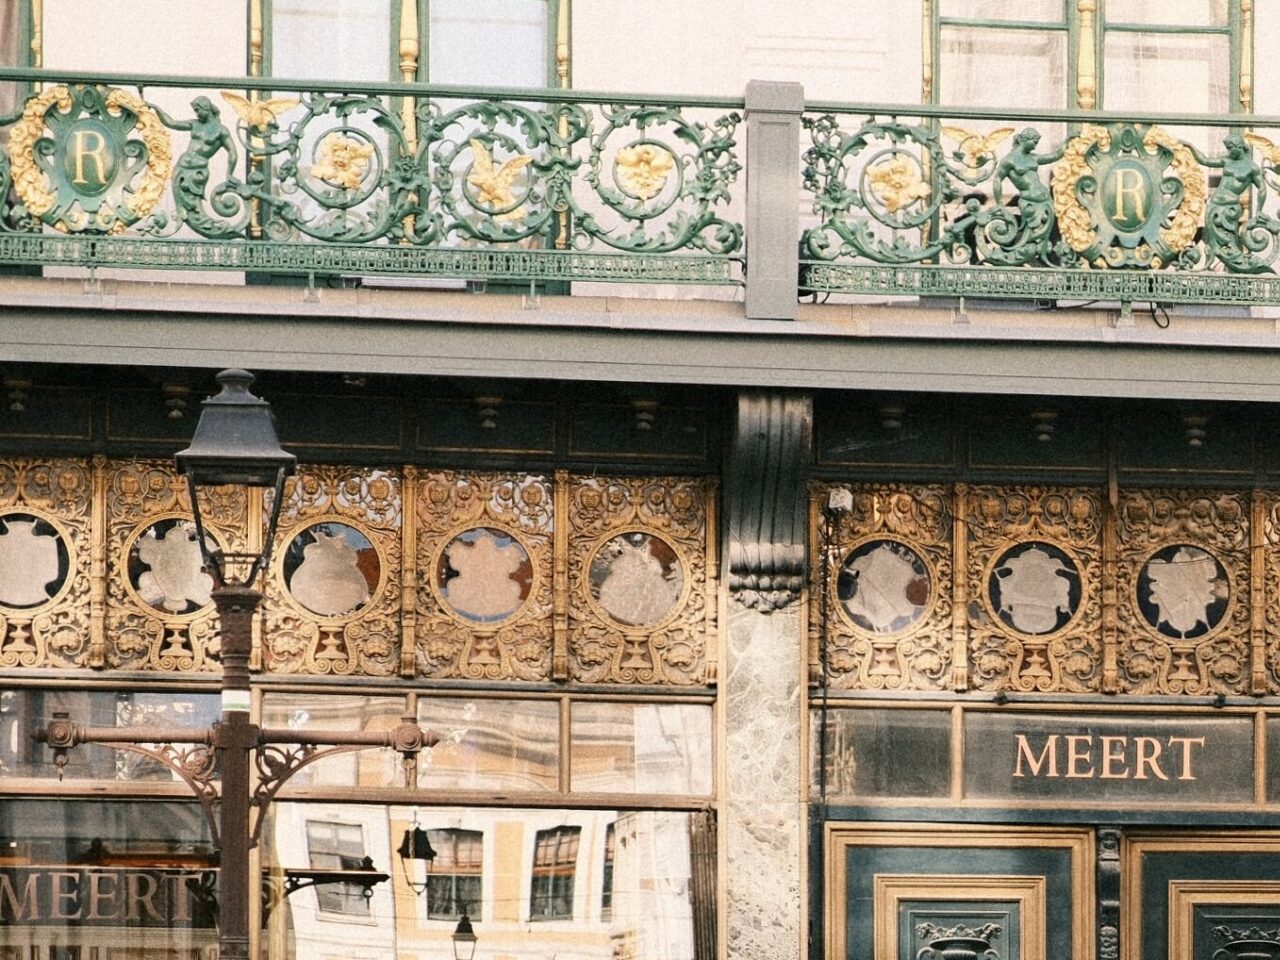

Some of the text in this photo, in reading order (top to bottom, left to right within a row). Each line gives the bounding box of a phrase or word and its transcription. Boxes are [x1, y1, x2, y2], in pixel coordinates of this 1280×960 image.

[73, 129, 107, 185] R
[1111, 167, 1146, 222] R
[1012, 733, 1206, 781] MEERT
[0, 871, 204, 922] MEERT
